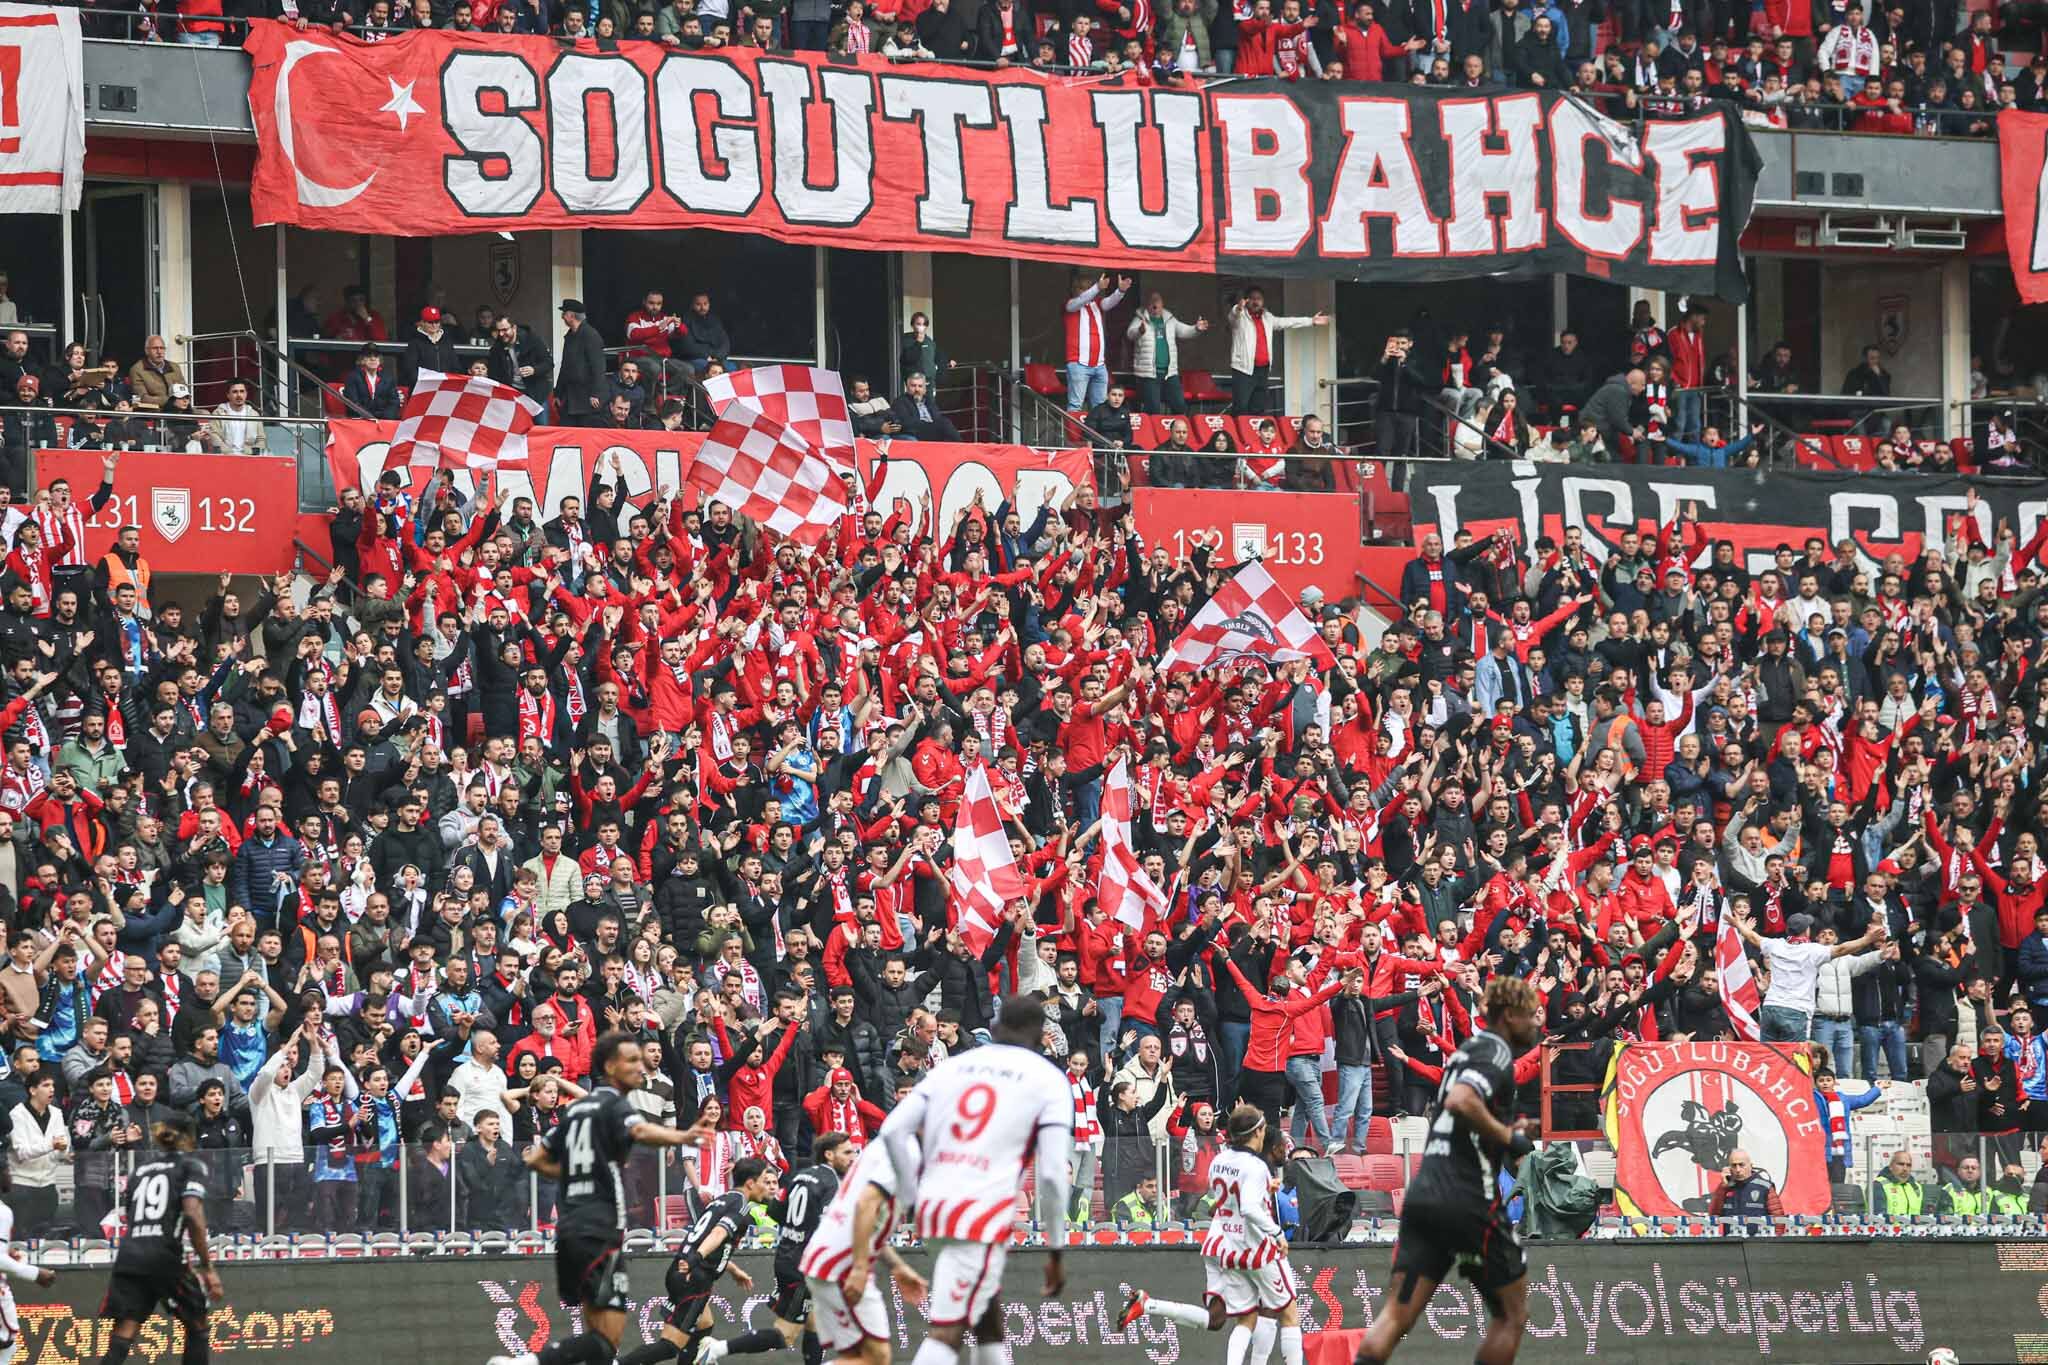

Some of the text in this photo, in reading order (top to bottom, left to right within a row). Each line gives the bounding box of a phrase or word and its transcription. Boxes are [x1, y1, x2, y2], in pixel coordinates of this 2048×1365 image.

[199, 496, 256, 533] 132
[1173, 529, 1224, 563] 12
[1273, 532, 1324, 565] 133
[950, 1082, 998, 1142] 9
[565, 1117, 595, 1176] 14
[132, 1174, 169, 1222] 19
[786, 1184, 808, 1227] 10
[1212, 1177, 1241, 1217] 21
